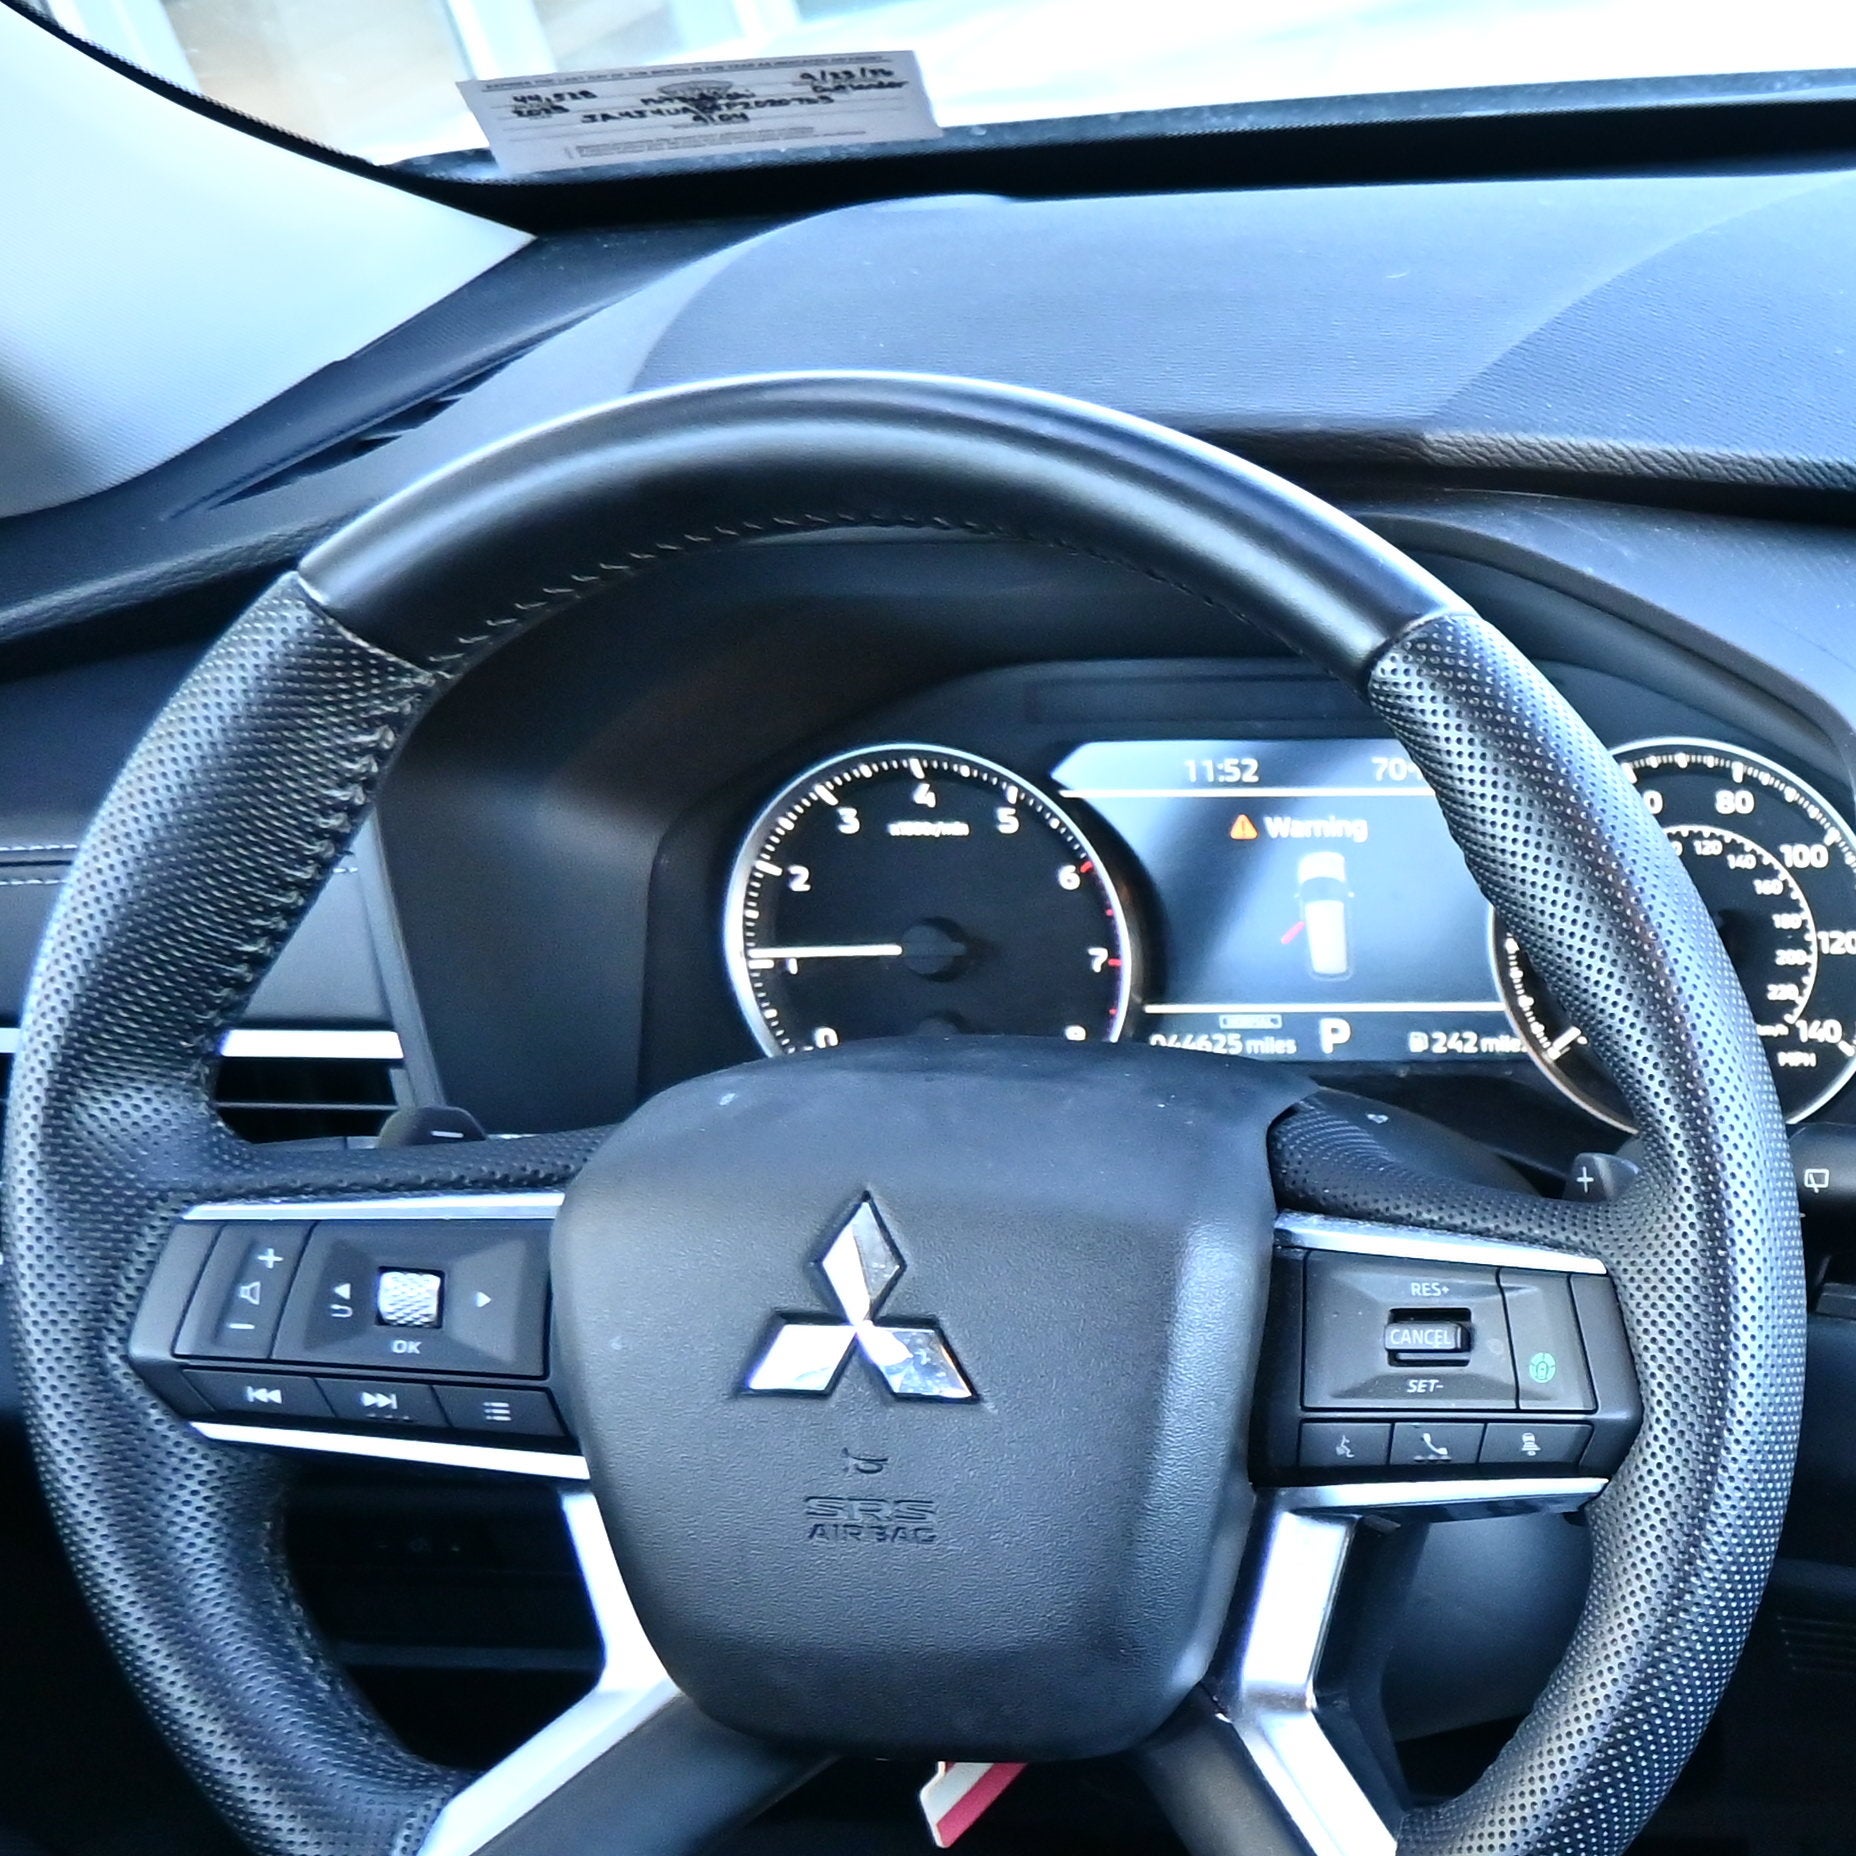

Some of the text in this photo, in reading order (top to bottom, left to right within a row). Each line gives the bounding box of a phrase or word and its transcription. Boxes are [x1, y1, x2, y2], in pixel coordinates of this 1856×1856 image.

[1184, 758, 1260, 784] 11:52
[913, 783, 936, 808] 4
[1715, 790, 1755, 816] 80
[837, 807, 860, 834] 3
[996, 806, 1019, 834] 5
[1264, 815, 1368, 842] Warning
[1693, 840, 1723, 856] 120
[1780, 843, 1829, 868] 100
[1726, 853, 1757, 870] 140
[787, 865, 811, 893] 2
[1056, 864, 1081, 890] 6
[1753, 879, 1783, 895] 160
[1772, 913, 1803, 929] 180
[1087, 947, 1109, 973] 7
[1319, 1017, 1351, 1054] P
[1430, 1031, 1478, 1053] 242
[1796, 1019, 1843, 1045] 140
[1244, 1036, 1297, 1054] miles
[1777, 1051, 1816, 1068] MPH
[1411, 1282, 1450, 1297] RES+
[391, 1339, 422, 1356] OK
[1390, 1328, 1452, 1346] CANCEL
[805, 1497, 936, 1521] SRS
[807, 1524, 937, 1543] AIRBAG
